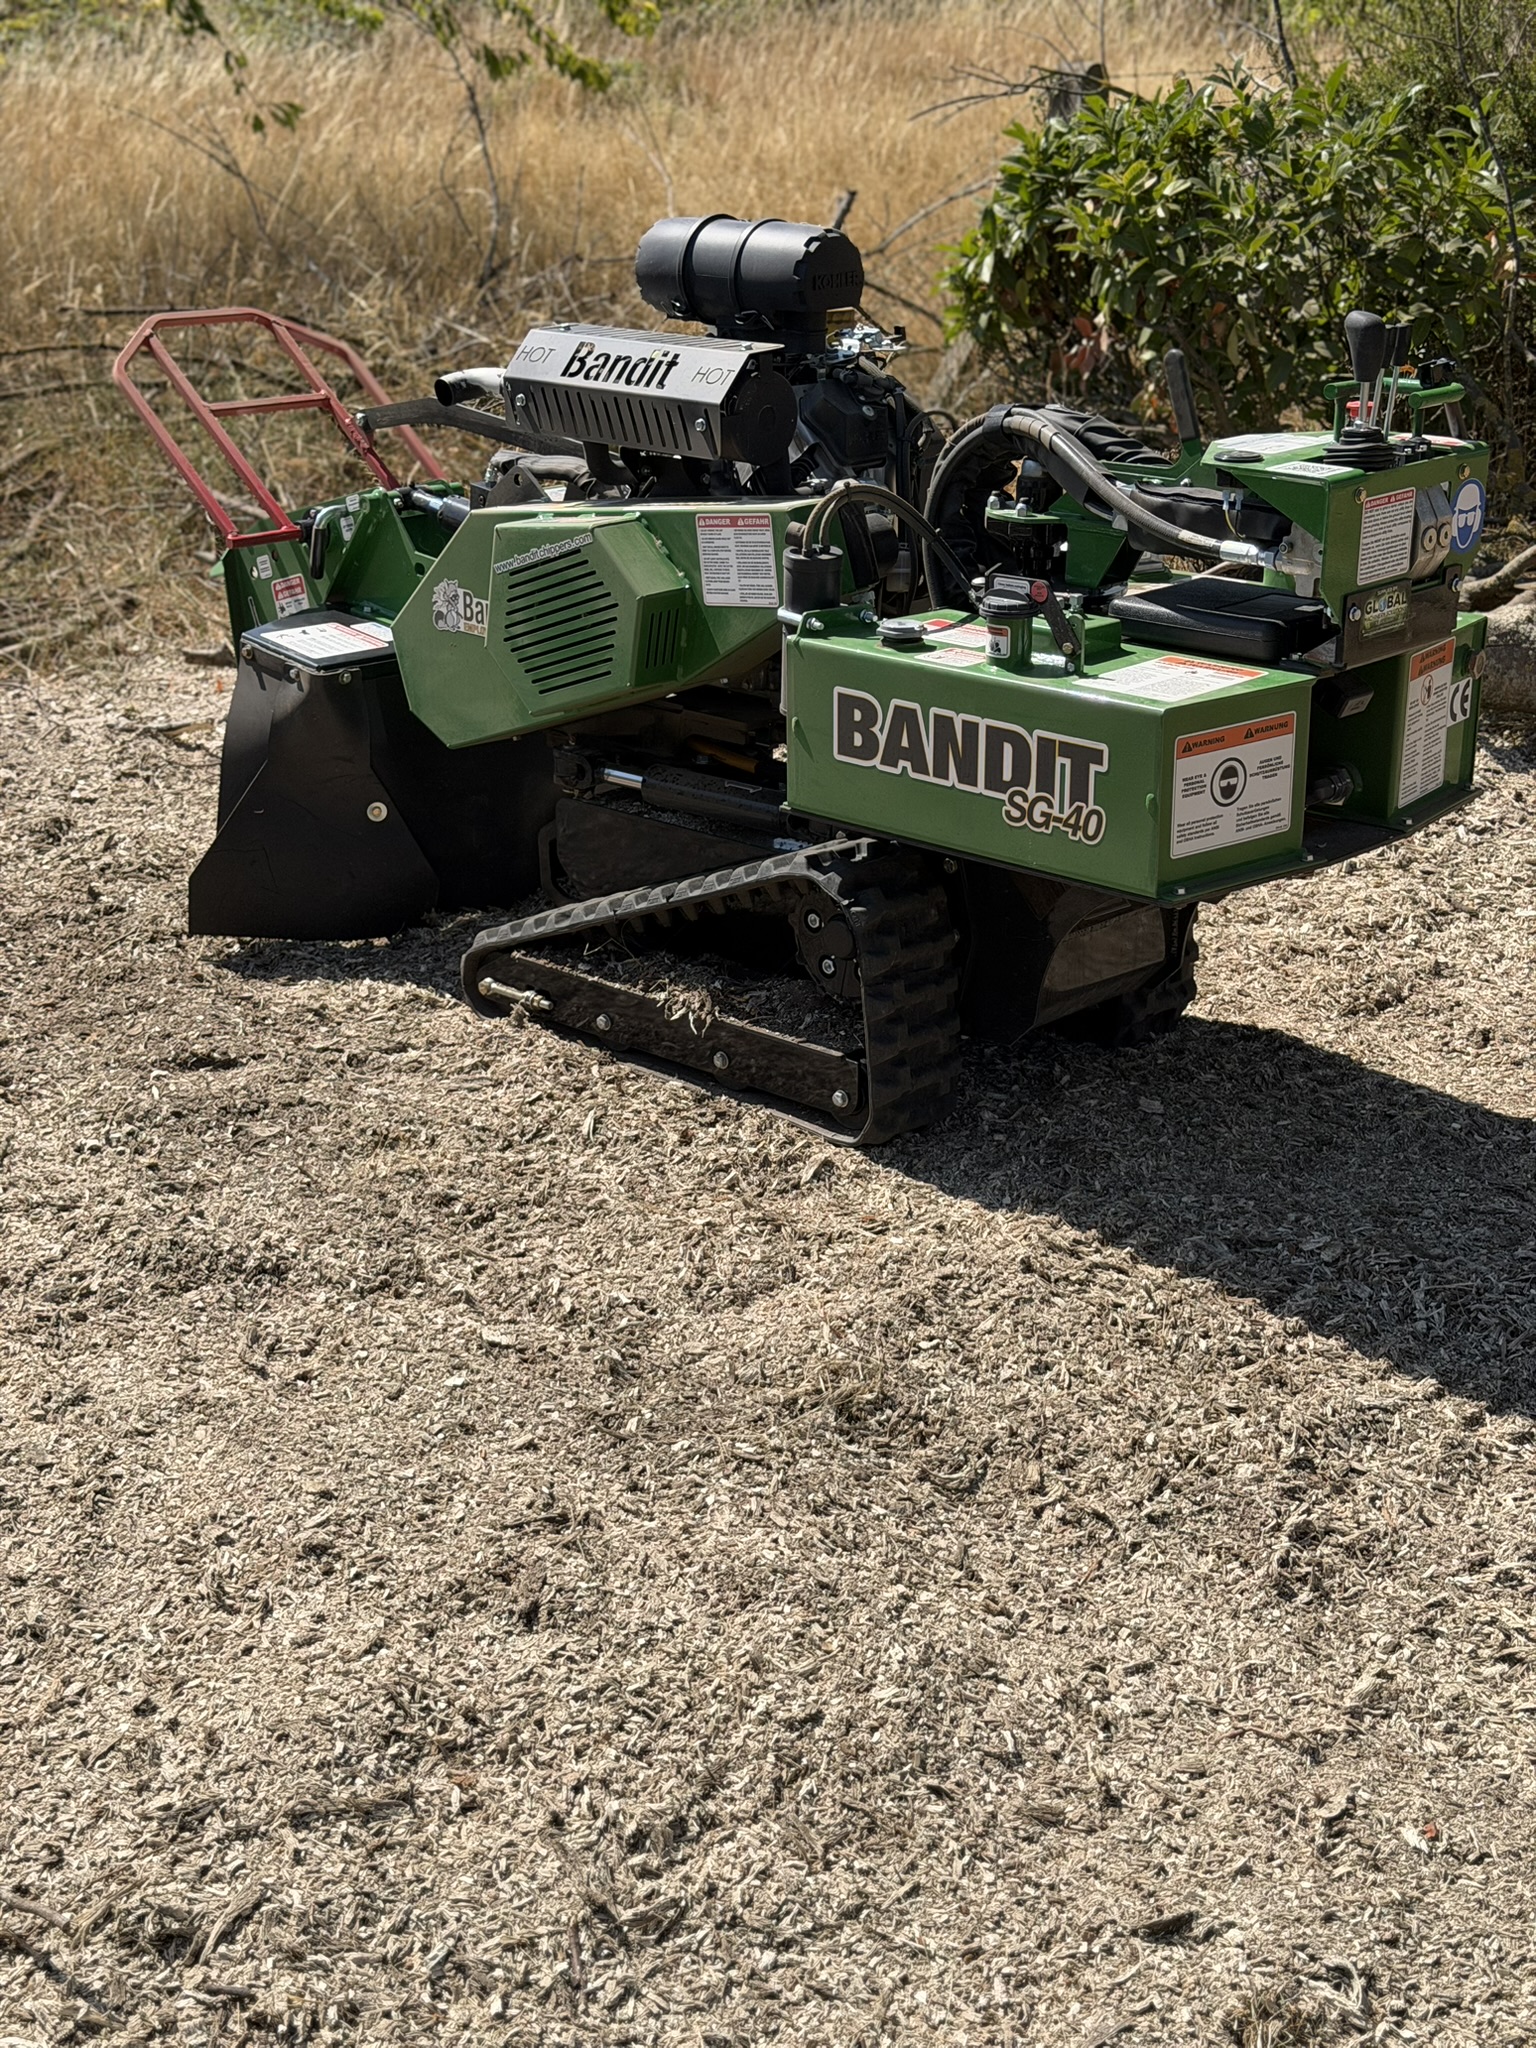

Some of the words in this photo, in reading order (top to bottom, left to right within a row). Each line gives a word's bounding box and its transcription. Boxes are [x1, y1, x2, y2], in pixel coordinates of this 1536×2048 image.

[515, 345, 556, 363] HOT
[560, 341, 681, 390] Bandit
[691, 366, 735, 386] HOT
[705, 518, 731, 526] DANGER
[744, 517, 769, 525] GEFAHR
[493, 532, 593, 575] www.banditchippers.com
[1365, 591, 1407, 615] GLOBAL
[1449, 679, 1471, 722] CE
[835, 688, 1106, 811] BANDIT
[1191, 736, 1225, 749] WARNING
[1253, 721, 1288, 735] WARNUNG
[1003, 788, 1104, 843] SG-40
